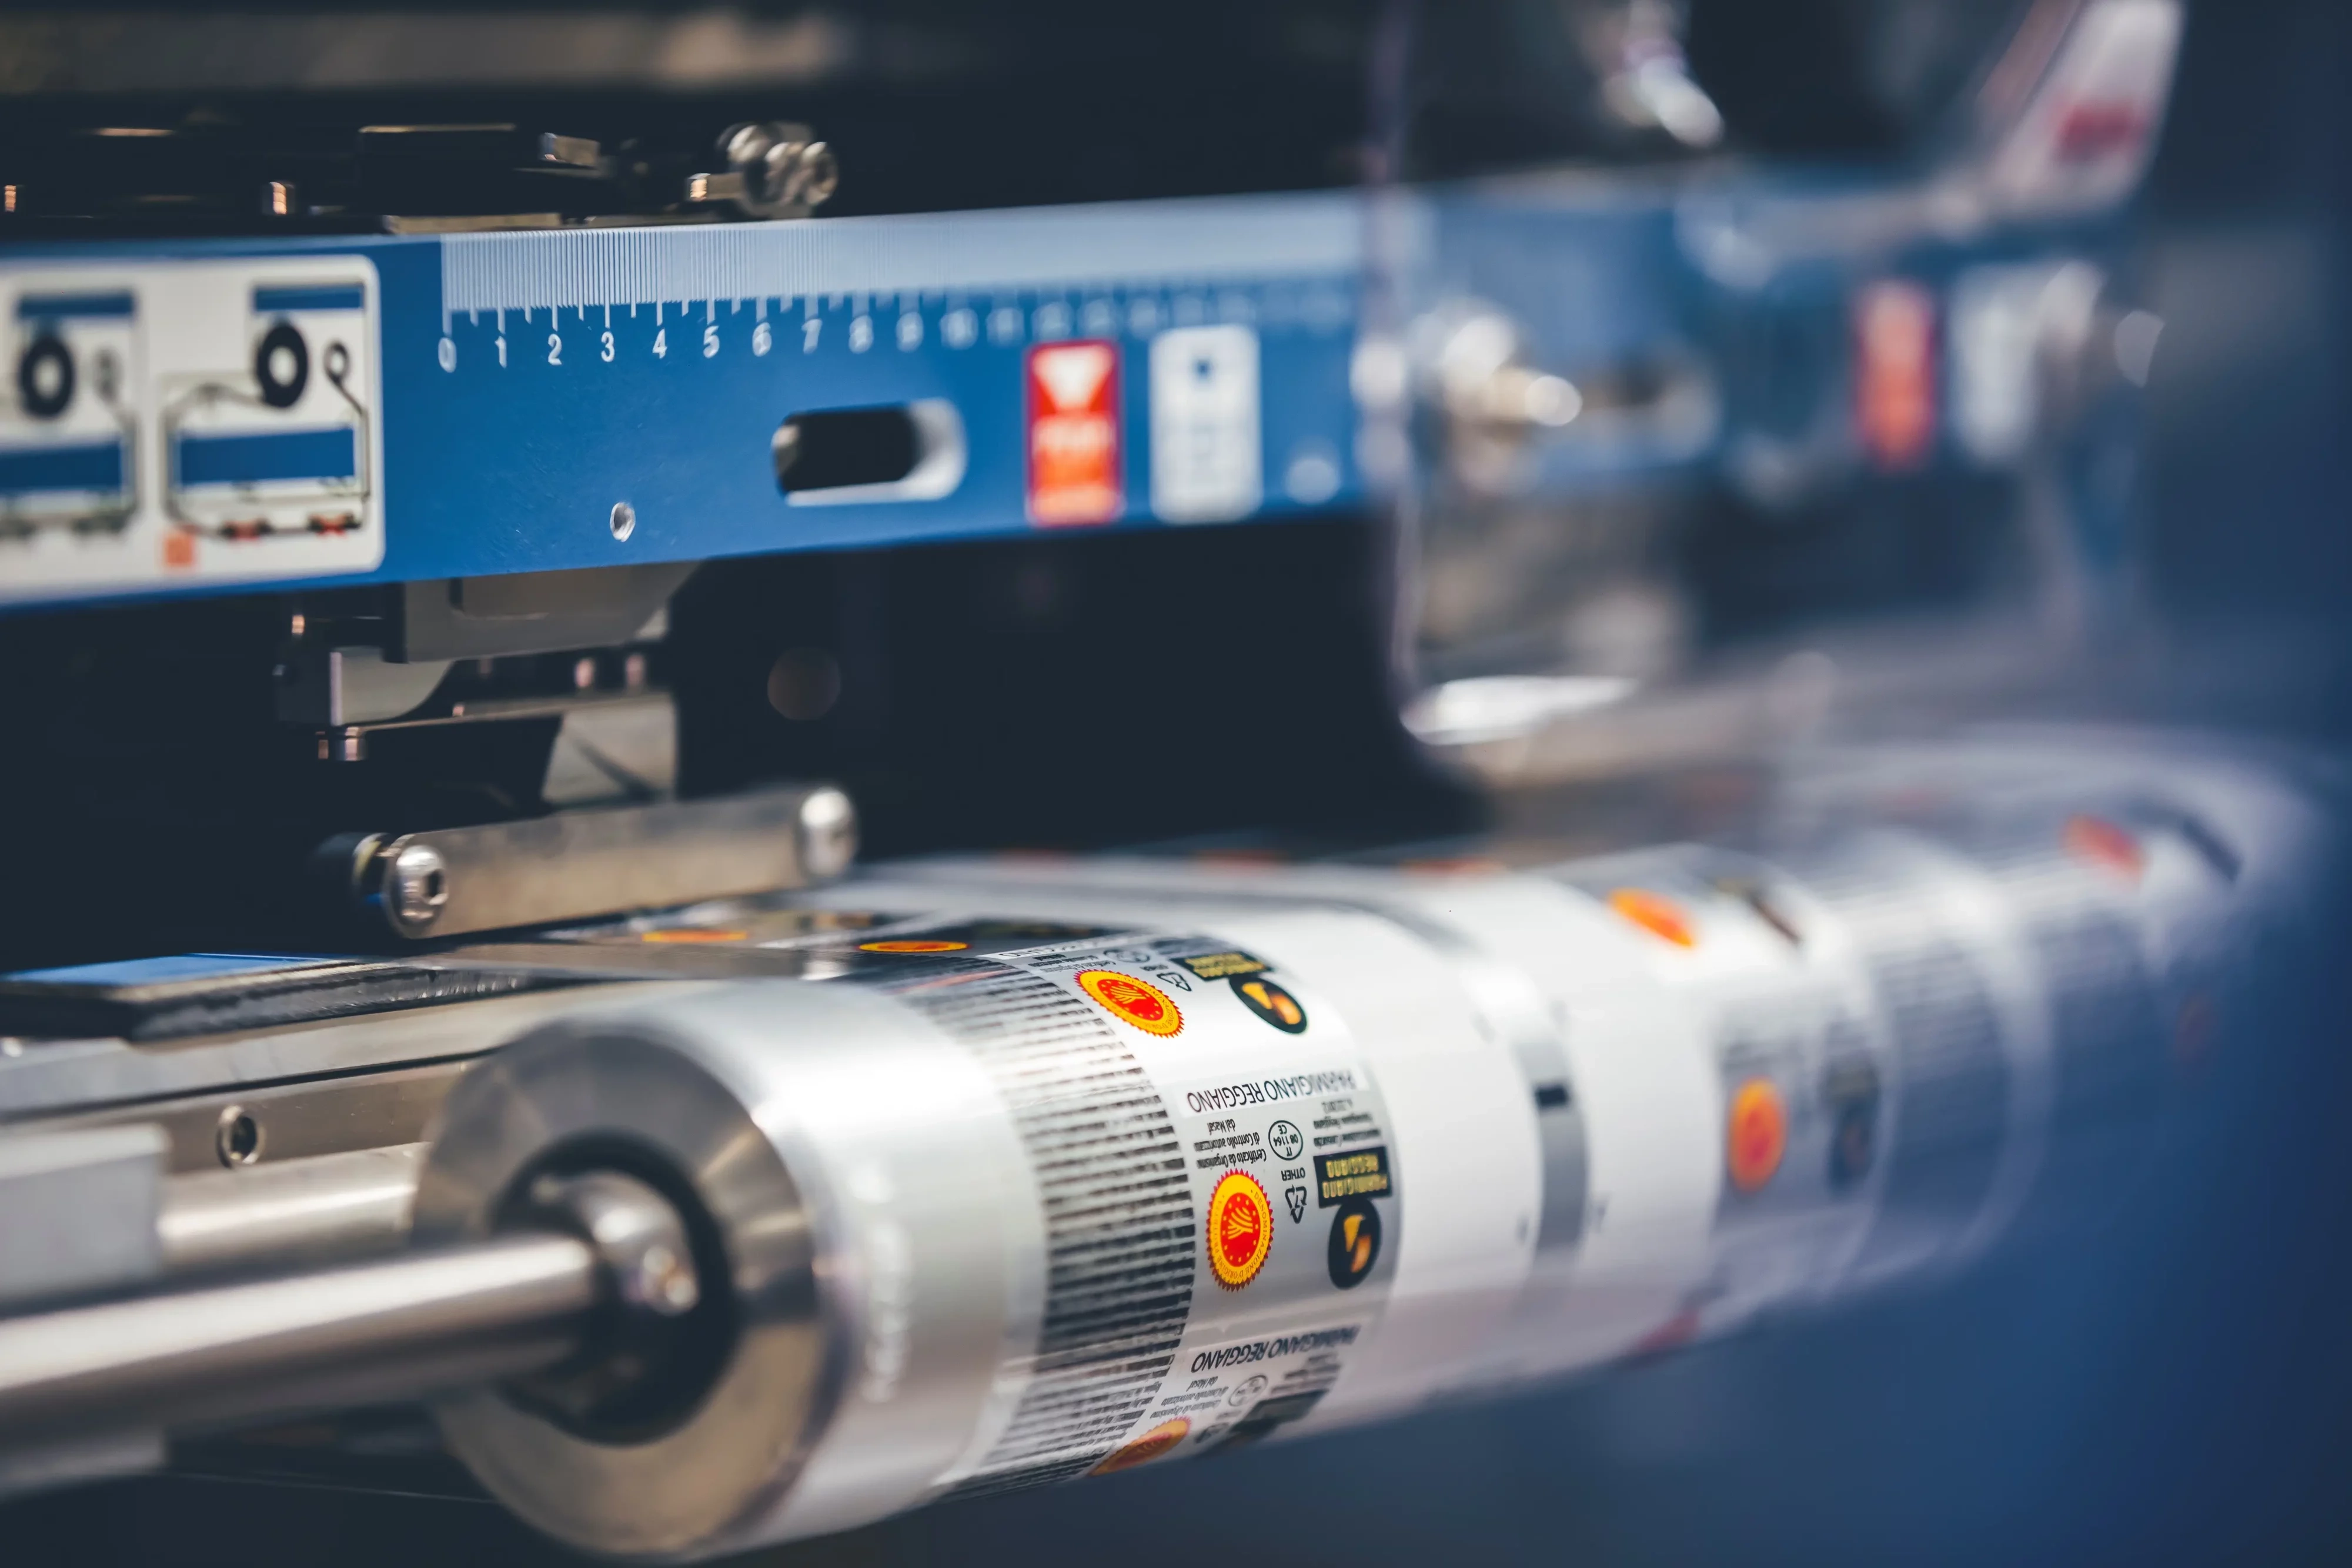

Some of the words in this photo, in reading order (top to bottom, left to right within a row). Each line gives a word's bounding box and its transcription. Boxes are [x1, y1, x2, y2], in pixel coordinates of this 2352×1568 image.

[438, 337, 457, 373] 0
[495, 336, 507, 368] 1
[547, 334, 562, 366] 2
[601, 332, 615, 363] 3
[652, 329, 667, 360] 4
[703, 325, 720, 359] 5
[752, 322, 772, 357] 6
[801, 318, 822, 354] 7
[1187, 1081, 1265, 1114] REGGIANO
[1225, 1118, 1236, 1132] dal
[1278, 1124, 1288, 1135] CE
[1226, 1134, 1254, 1149] Controllo
[1253, 1132, 1260, 1146] di
[1273, 1135, 1289, 1147] 1164
[1236, 1148, 1267, 1165] Certificato
[1286, 1146, 1292, 1157] IT
[1228, 1153, 1237, 1167] da
[1281, 1168, 1306, 1182] OTHER
[1245, 1192, 1268, 1276] DENOMINAZIONE
[1191, 1341, 1270, 1373] REGGIANO
